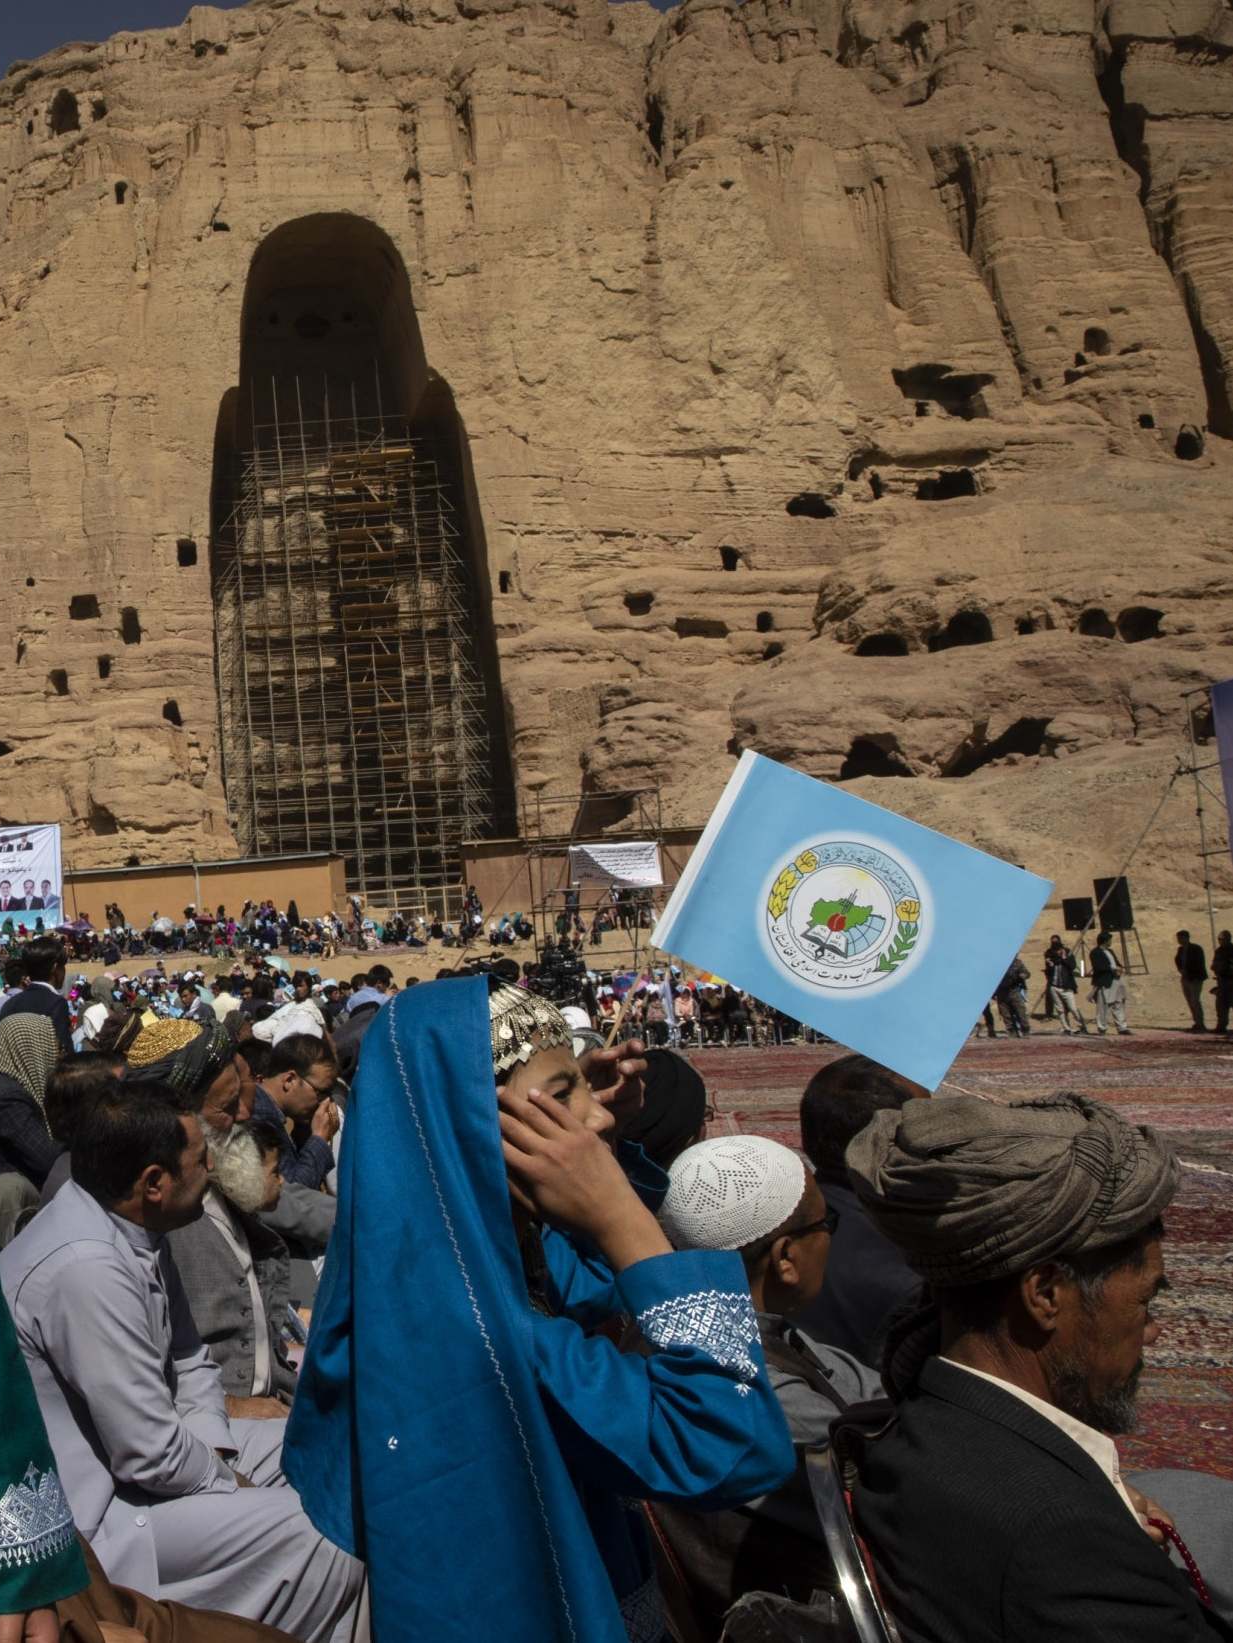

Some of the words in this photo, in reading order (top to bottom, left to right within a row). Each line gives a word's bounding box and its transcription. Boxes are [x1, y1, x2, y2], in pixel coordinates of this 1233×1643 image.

[772, 925, 797, 958] افغانستان
[791, 960, 817, 973] اسلامی
[818, 970, 848, 980] وحدت
[850, 968, 872, 982] حزب
